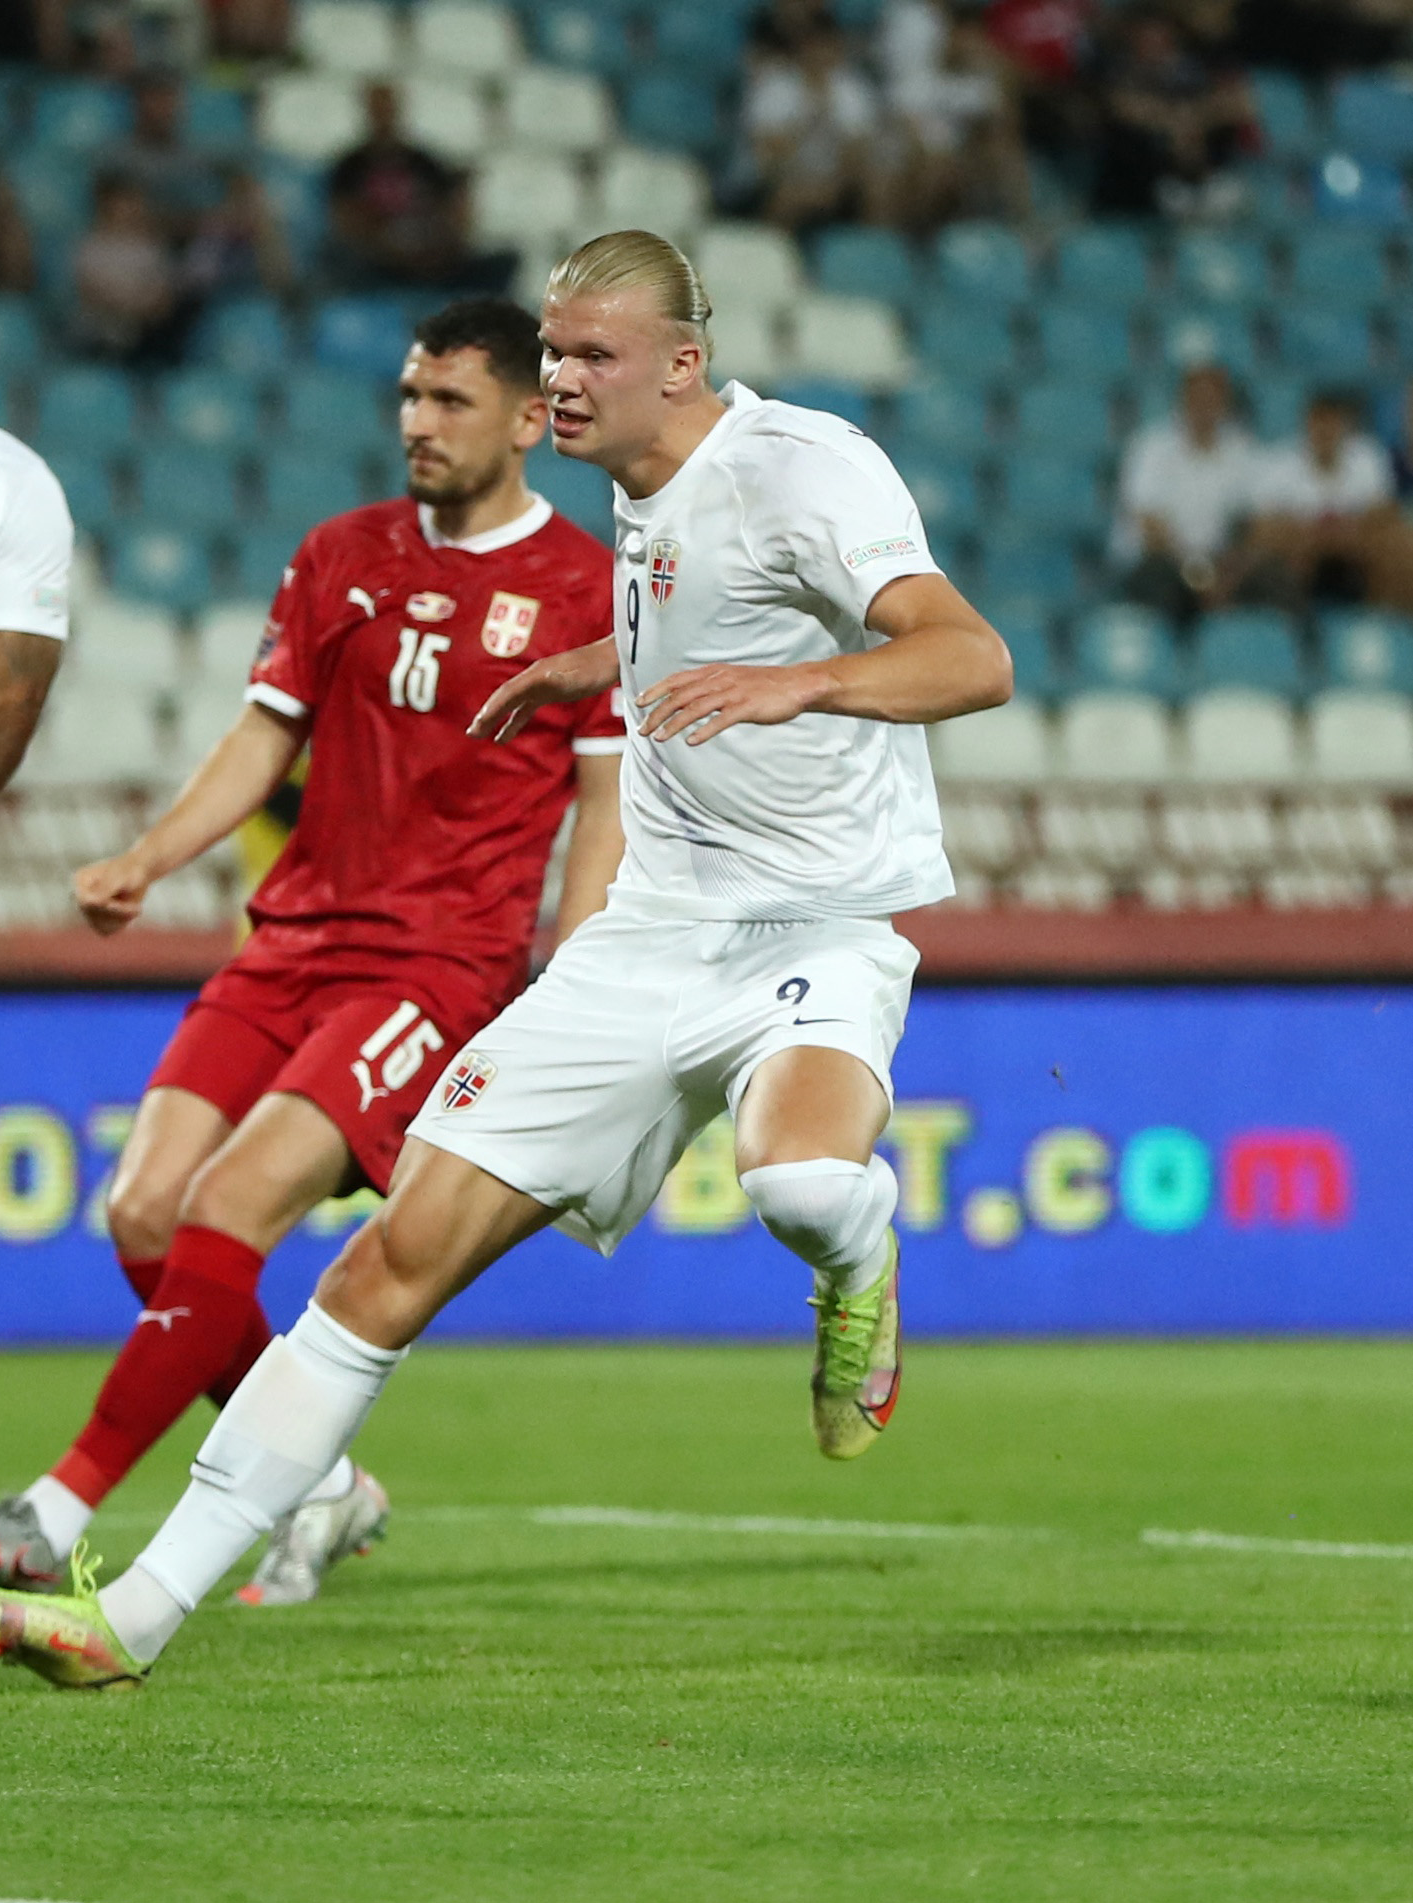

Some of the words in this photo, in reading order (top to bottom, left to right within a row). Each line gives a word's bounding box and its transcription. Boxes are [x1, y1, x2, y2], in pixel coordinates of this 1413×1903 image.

[626, 578, 640, 665] 9
[389, 627, 452, 713] 15
[776, 977, 811, 1006] 9
[359, 999, 444, 1091] 15
